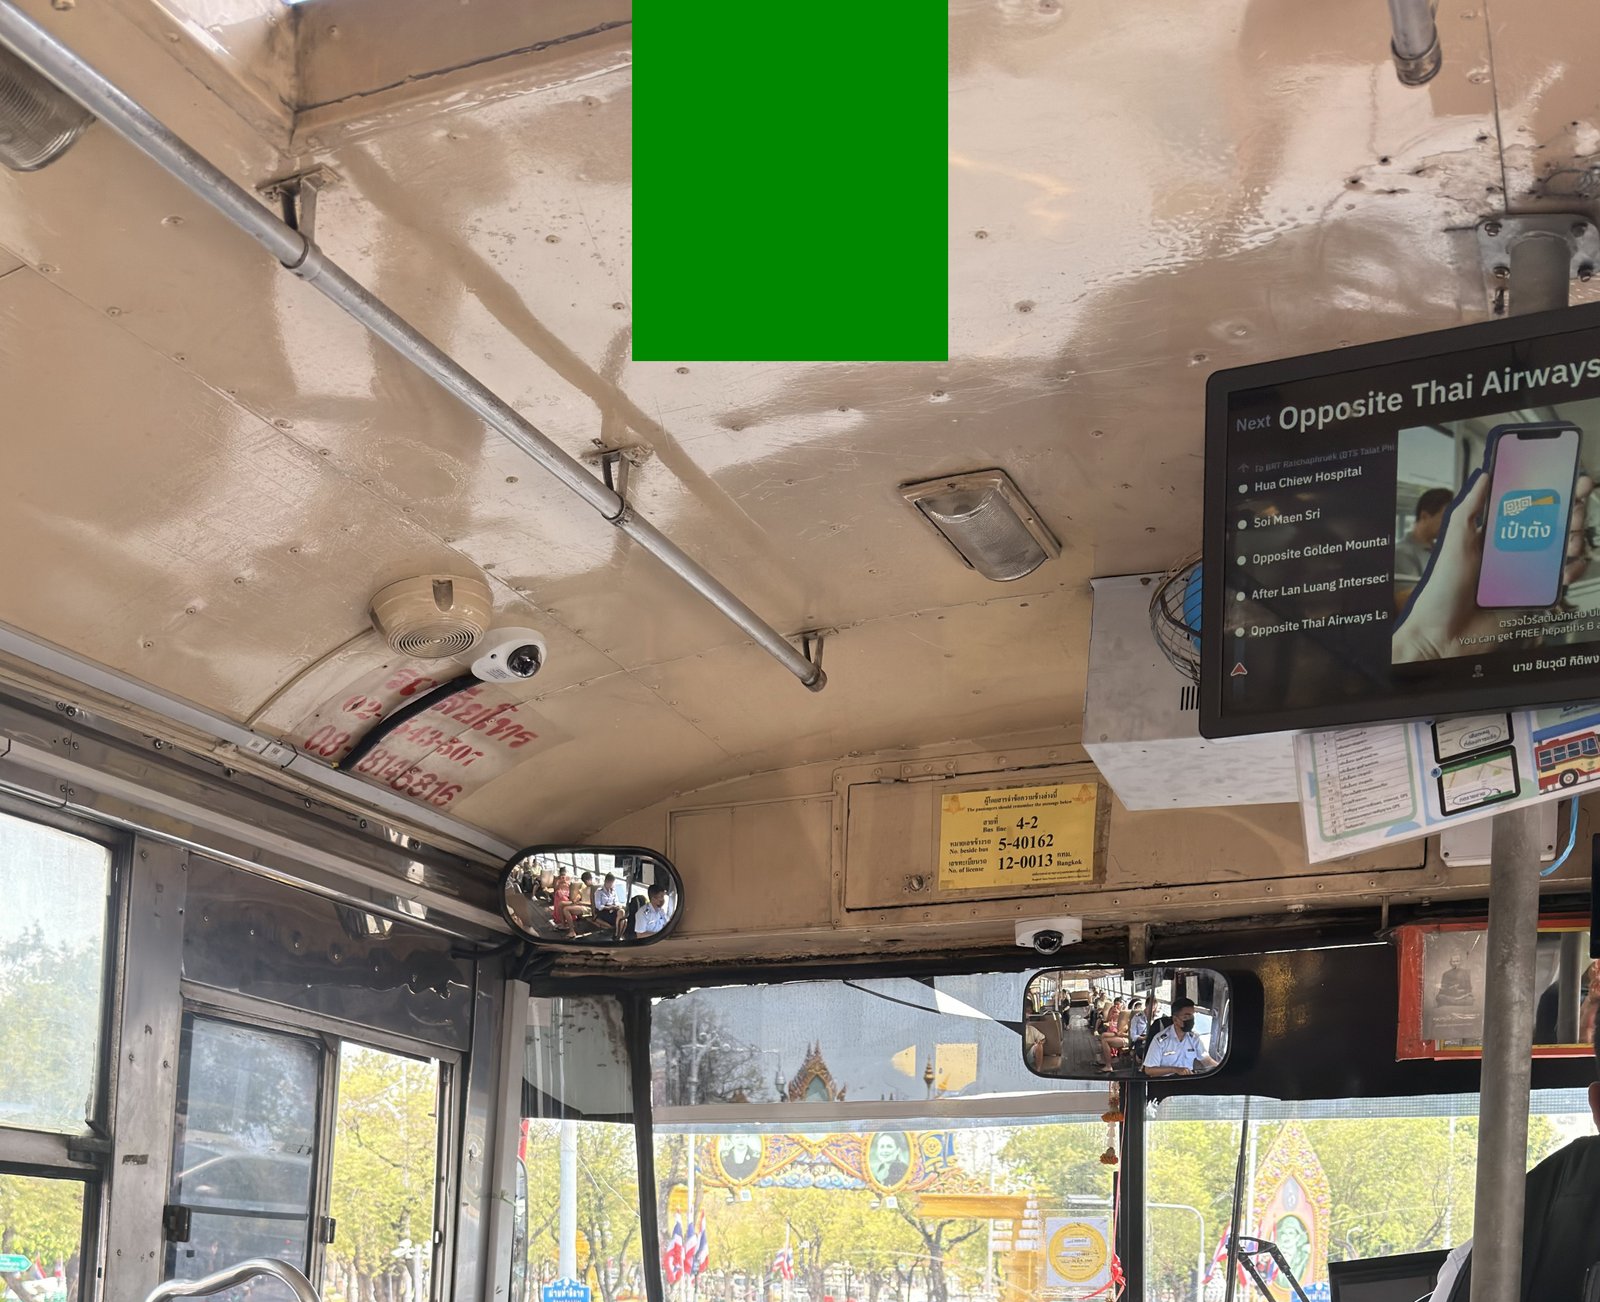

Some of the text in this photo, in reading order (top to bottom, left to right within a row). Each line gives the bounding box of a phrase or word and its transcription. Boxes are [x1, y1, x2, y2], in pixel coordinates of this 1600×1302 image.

[1236, 357, 1600, 433] Next Opposite Thai Airways
[1265, 462, 1282, 472] BRT
[1254, 465, 1362, 493] Hua Chiew Hospital
[1254, 508, 1321, 529] Soi Maen Sri
[1252, 547, 1301, 566] Opposite
[1303, 540, 1343, 558] Golden
[1251, 584, 1279, 601] After
[1281, 583, 1301, 596] Lan
[1303, 580, 1336, 597] Luang
[1250, 621, 1299, 640] Opposite
[1301, 617, 1328, 632] Thai
[1330, 614, 1373, 632] Airways
[1459, 636, 1476, 645] You
[1478, 635, 1496, 643] can
[1497, 632, 1513, 643] get
[1515, 629, 1540, 638] FREE
[1541, 624, 1585, 637] hepatitis
[1586, 622, 1594, 631] B
[1512, 661, 1533, 673] นาย
[1016, 816, 1038, 829] 4-2
[998, 834, 1054, 851] 5-40162
[998, 854, 1053, 870] 12-0013
[1056, 859, 1082, 867] Bangkok
